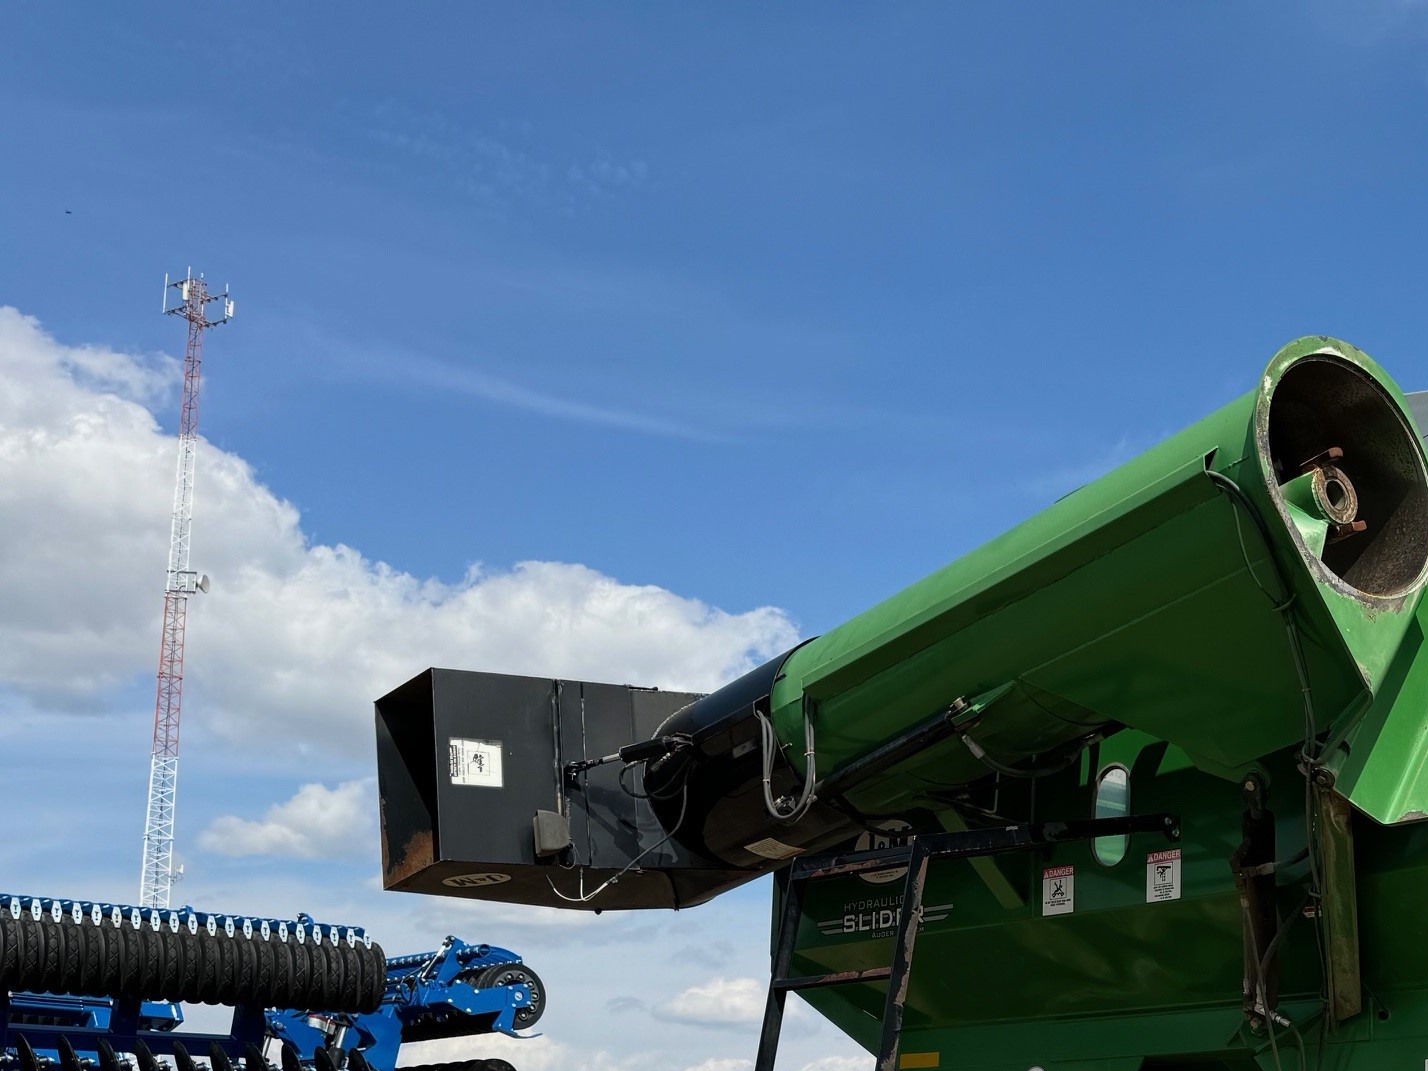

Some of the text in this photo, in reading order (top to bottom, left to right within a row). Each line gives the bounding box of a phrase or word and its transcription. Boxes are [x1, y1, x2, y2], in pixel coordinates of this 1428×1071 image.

[1153, 850, 1181, 860] DANGER
[1048, 867, 1074, 878] DANGER
[871, 930, 895, 939] AUGER
